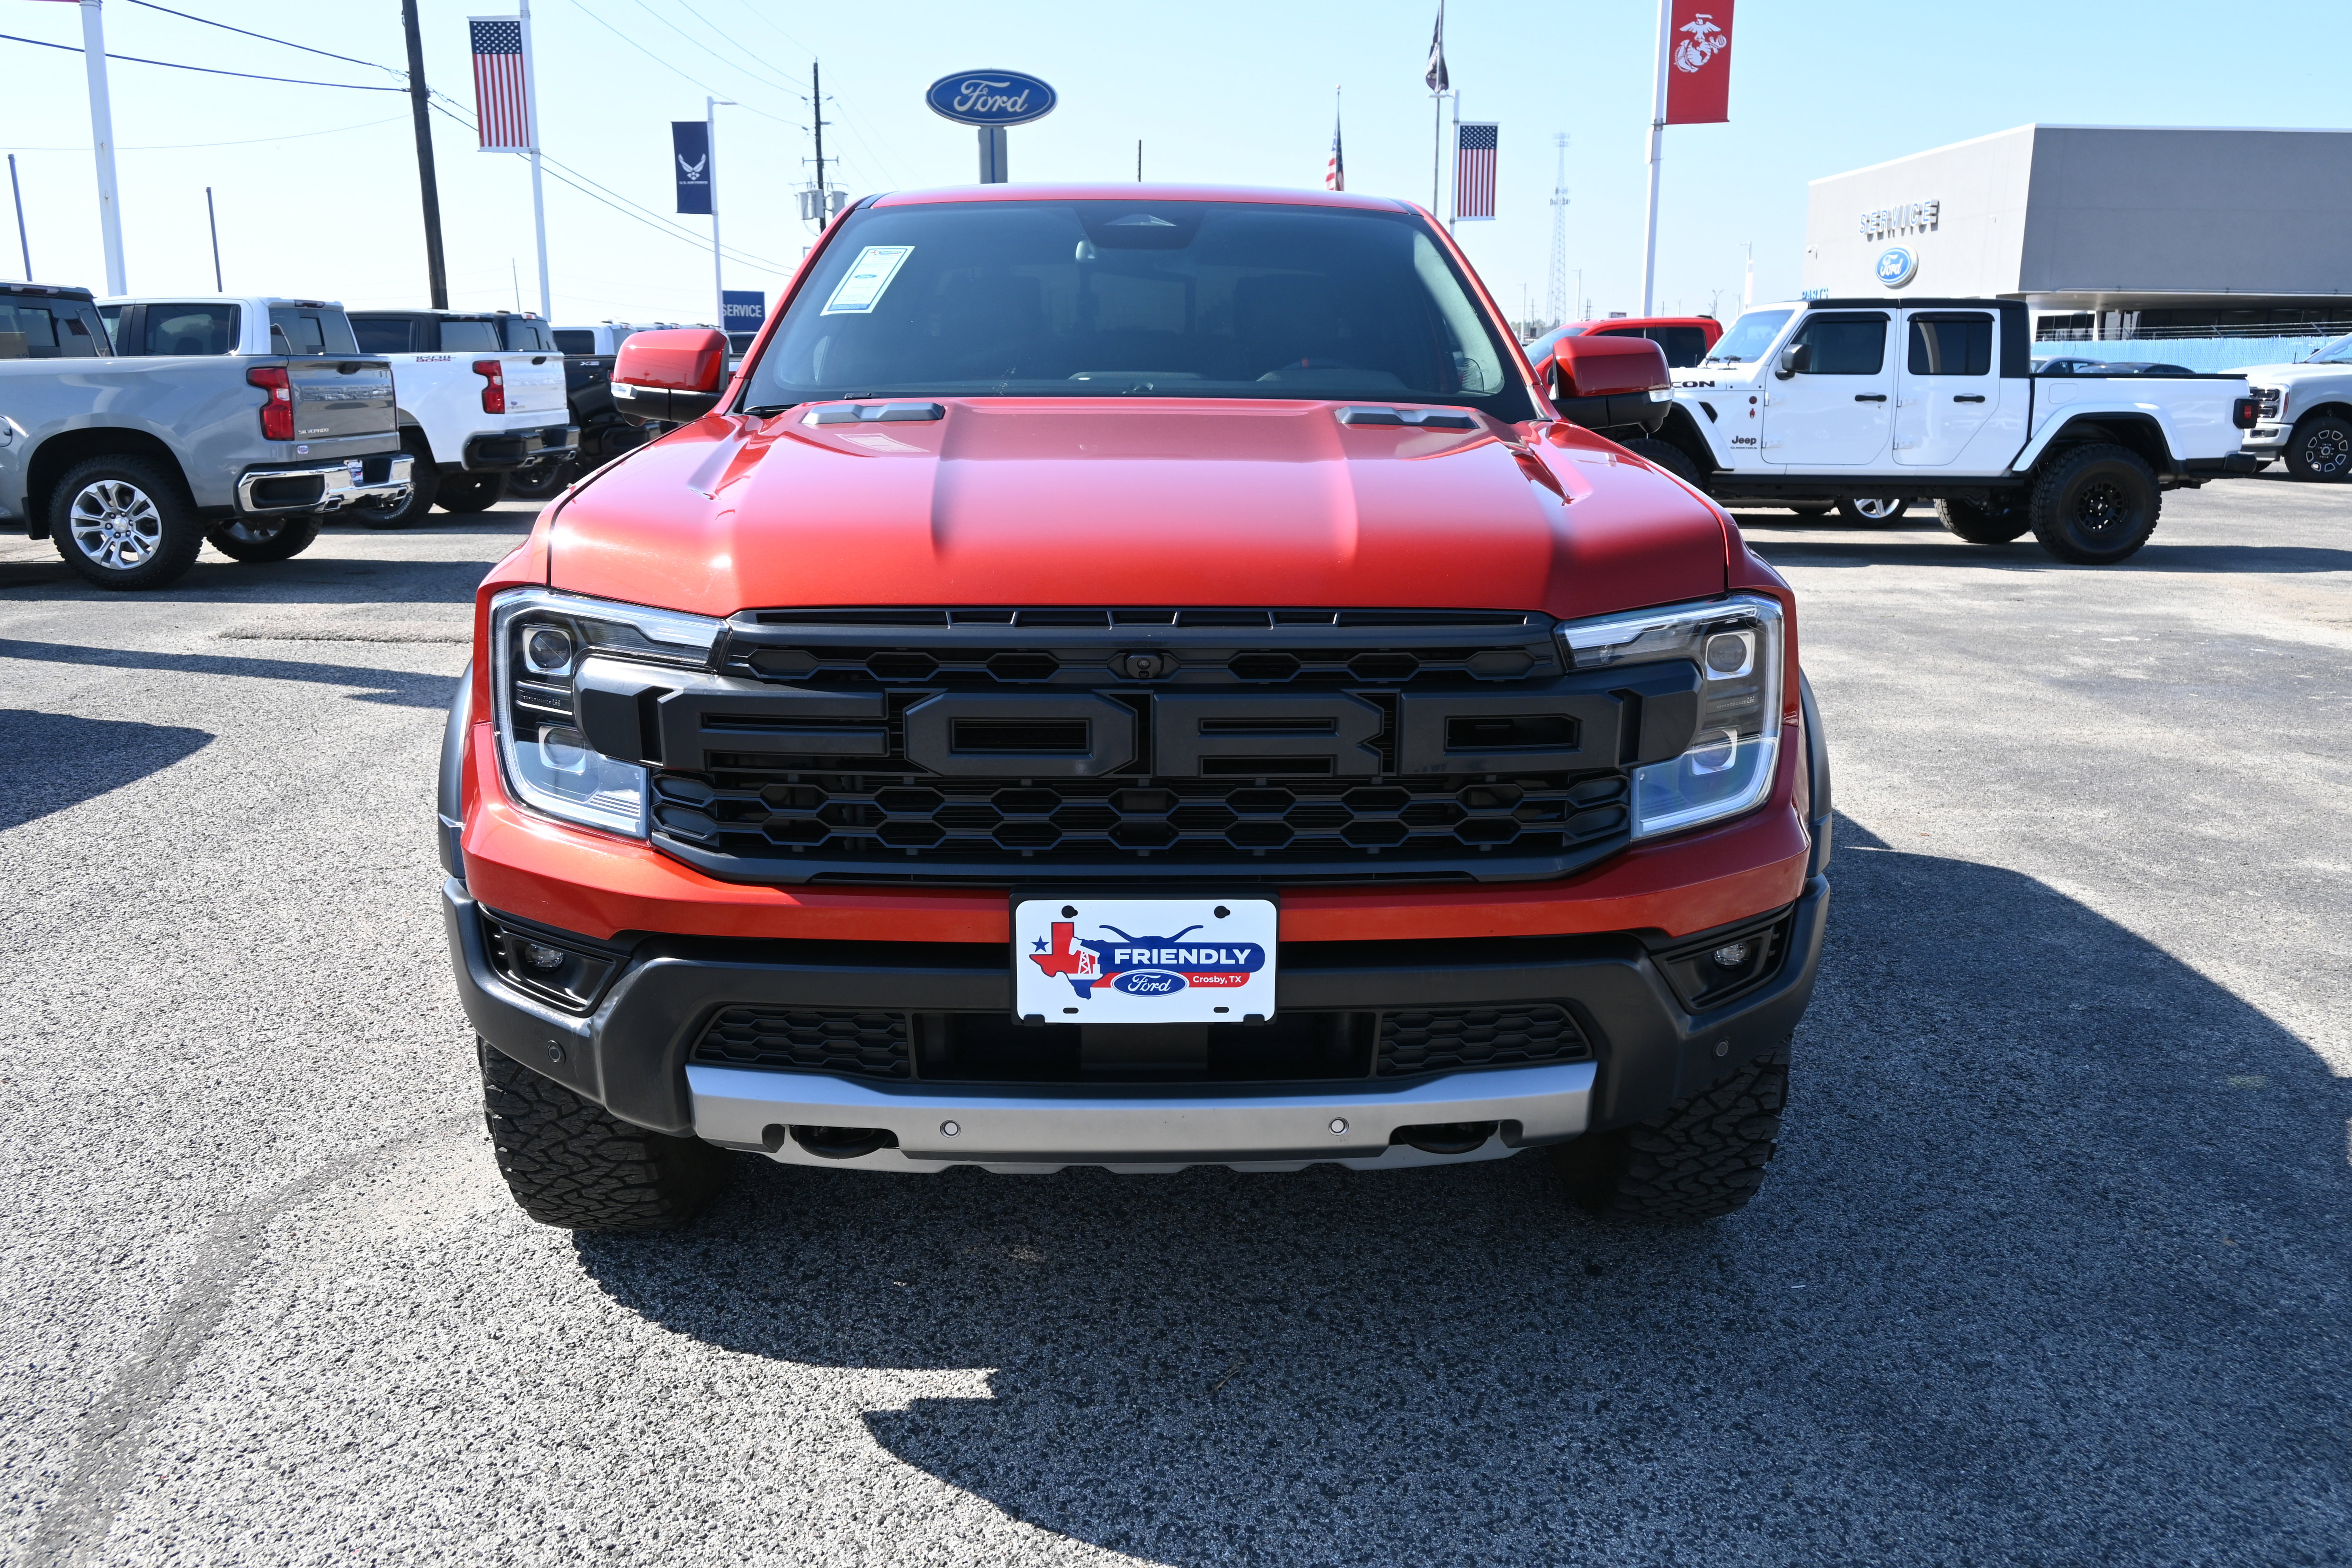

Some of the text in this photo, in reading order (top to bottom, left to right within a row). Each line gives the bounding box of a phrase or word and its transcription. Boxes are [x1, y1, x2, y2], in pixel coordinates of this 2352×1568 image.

[953, 79, 1029, 112] Ford
[1859, 199, 1938, 235] SERVICE
[1880, 254, 1903, 277] Ford
[723, 304, 762, 317] SERVICE
[1731, 435, 1757, 445] Jeep
[658, 684, 1623, 777] FORD
[1114, 949, 1252, 964] FRIENDLY
[1127, 974, 1172, 992] Ford
[1192, 975, 1227, 984] Crosby,
